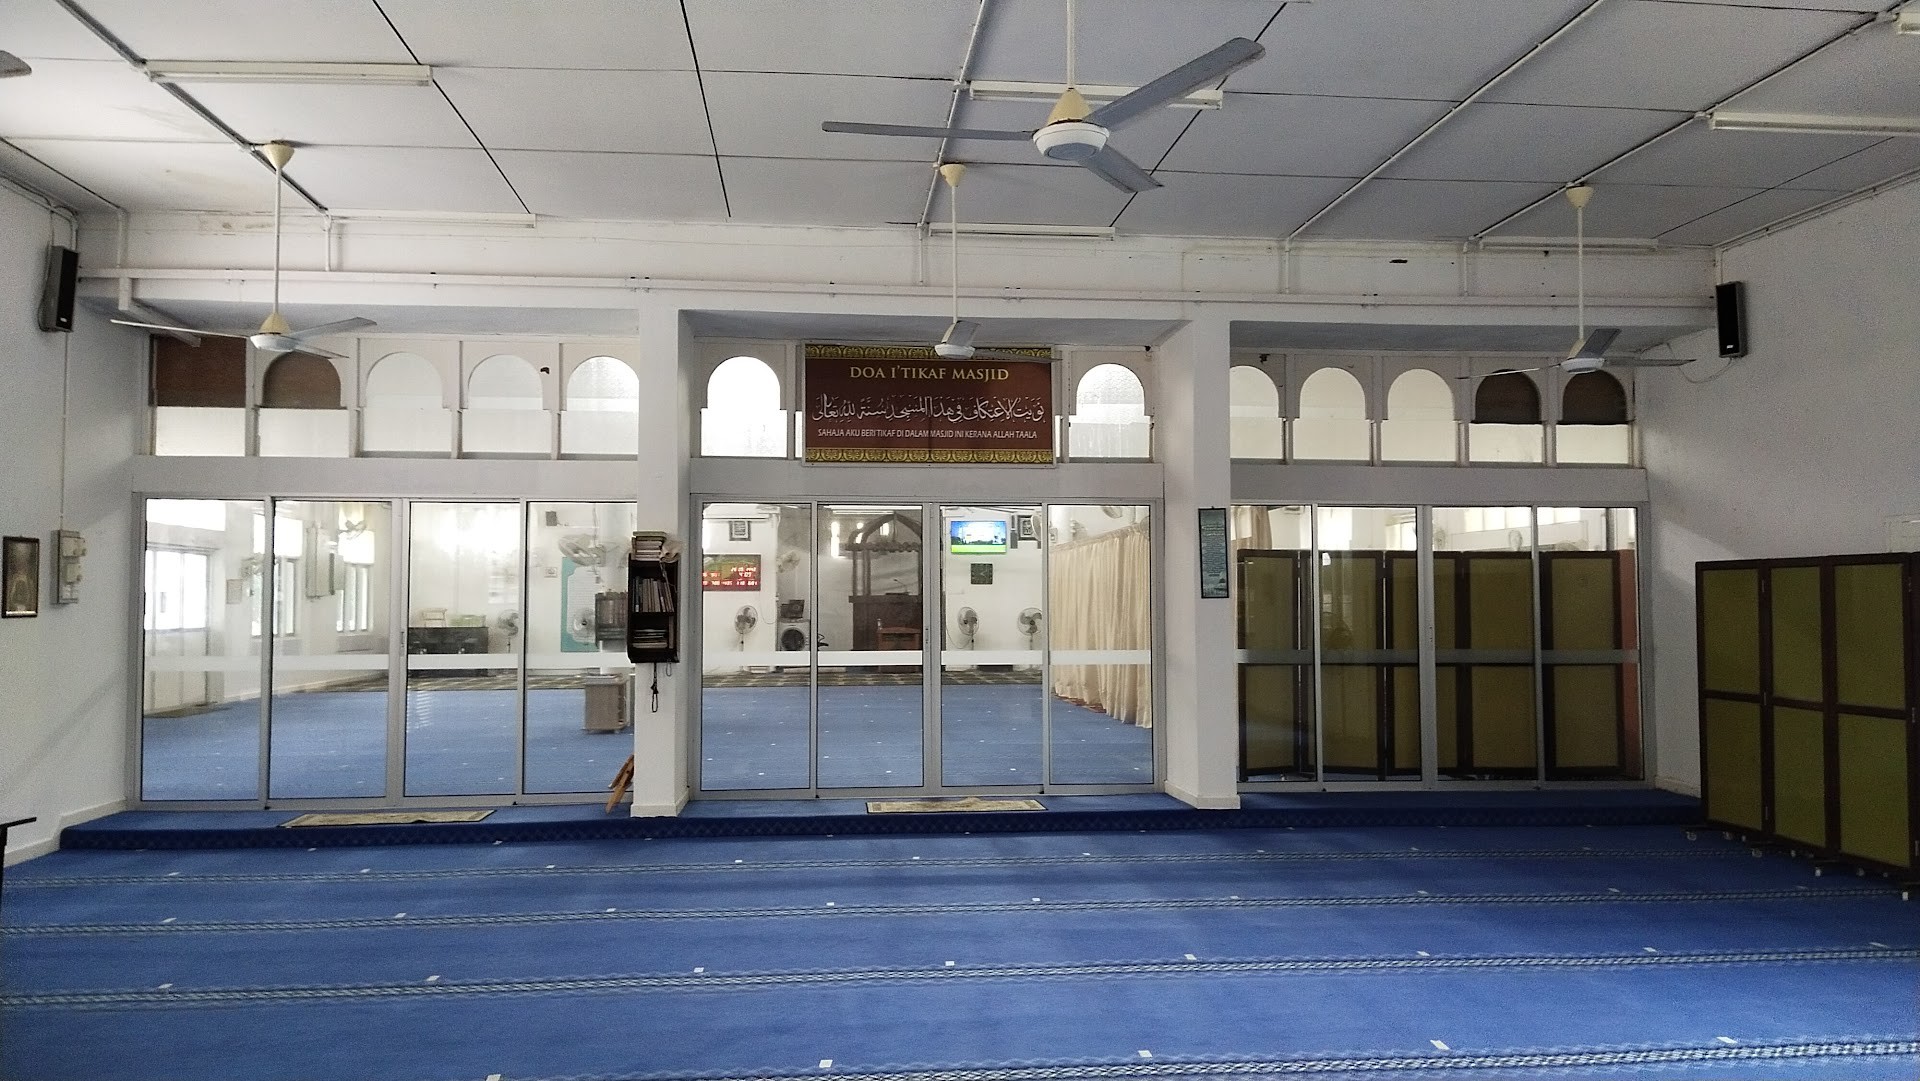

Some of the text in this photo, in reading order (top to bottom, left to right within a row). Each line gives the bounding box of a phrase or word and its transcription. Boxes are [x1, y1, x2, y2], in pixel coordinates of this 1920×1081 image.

[850, 365, 1009, 382] DOA I'TIKAF MASJID
[818, 428, 845, 437] SAHAJA
[845, 429, 860, 437] AKU
[897, 429, 904, 438] DI
[905, 430, 929, 438] DALAM
[930, 430, 954, 438] MASJID
[955, 430, 964, 438] INI
[965, 430, 992, 438] KERANA
[993, 430, 1015, 438] ALLAH
[1016, 431, 1038, 439] TAALA
